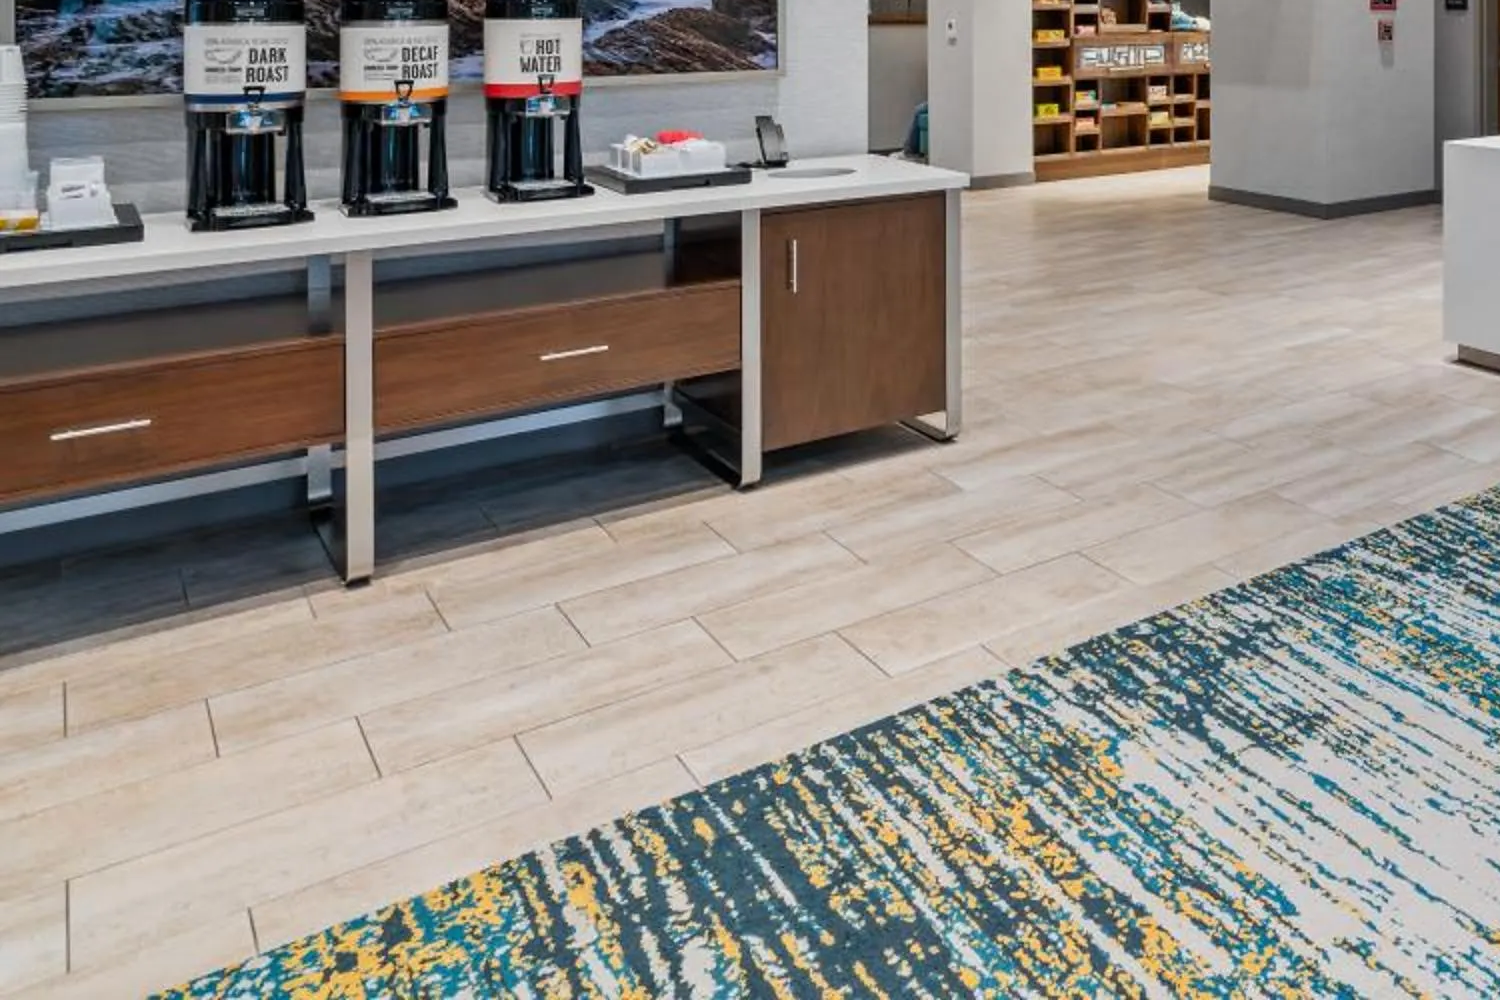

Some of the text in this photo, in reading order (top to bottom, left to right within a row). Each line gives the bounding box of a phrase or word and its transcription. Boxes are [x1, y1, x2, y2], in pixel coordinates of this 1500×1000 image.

[248, 47, 288, 65] DARK
[401, 45, 439, 63] DECAF
[535, 39, 561, 55] HOT
[401, 62, 439, 80] ROAST
[519, 55, 562, 73] WATER
[245, 65, 289, 84] ROAST
